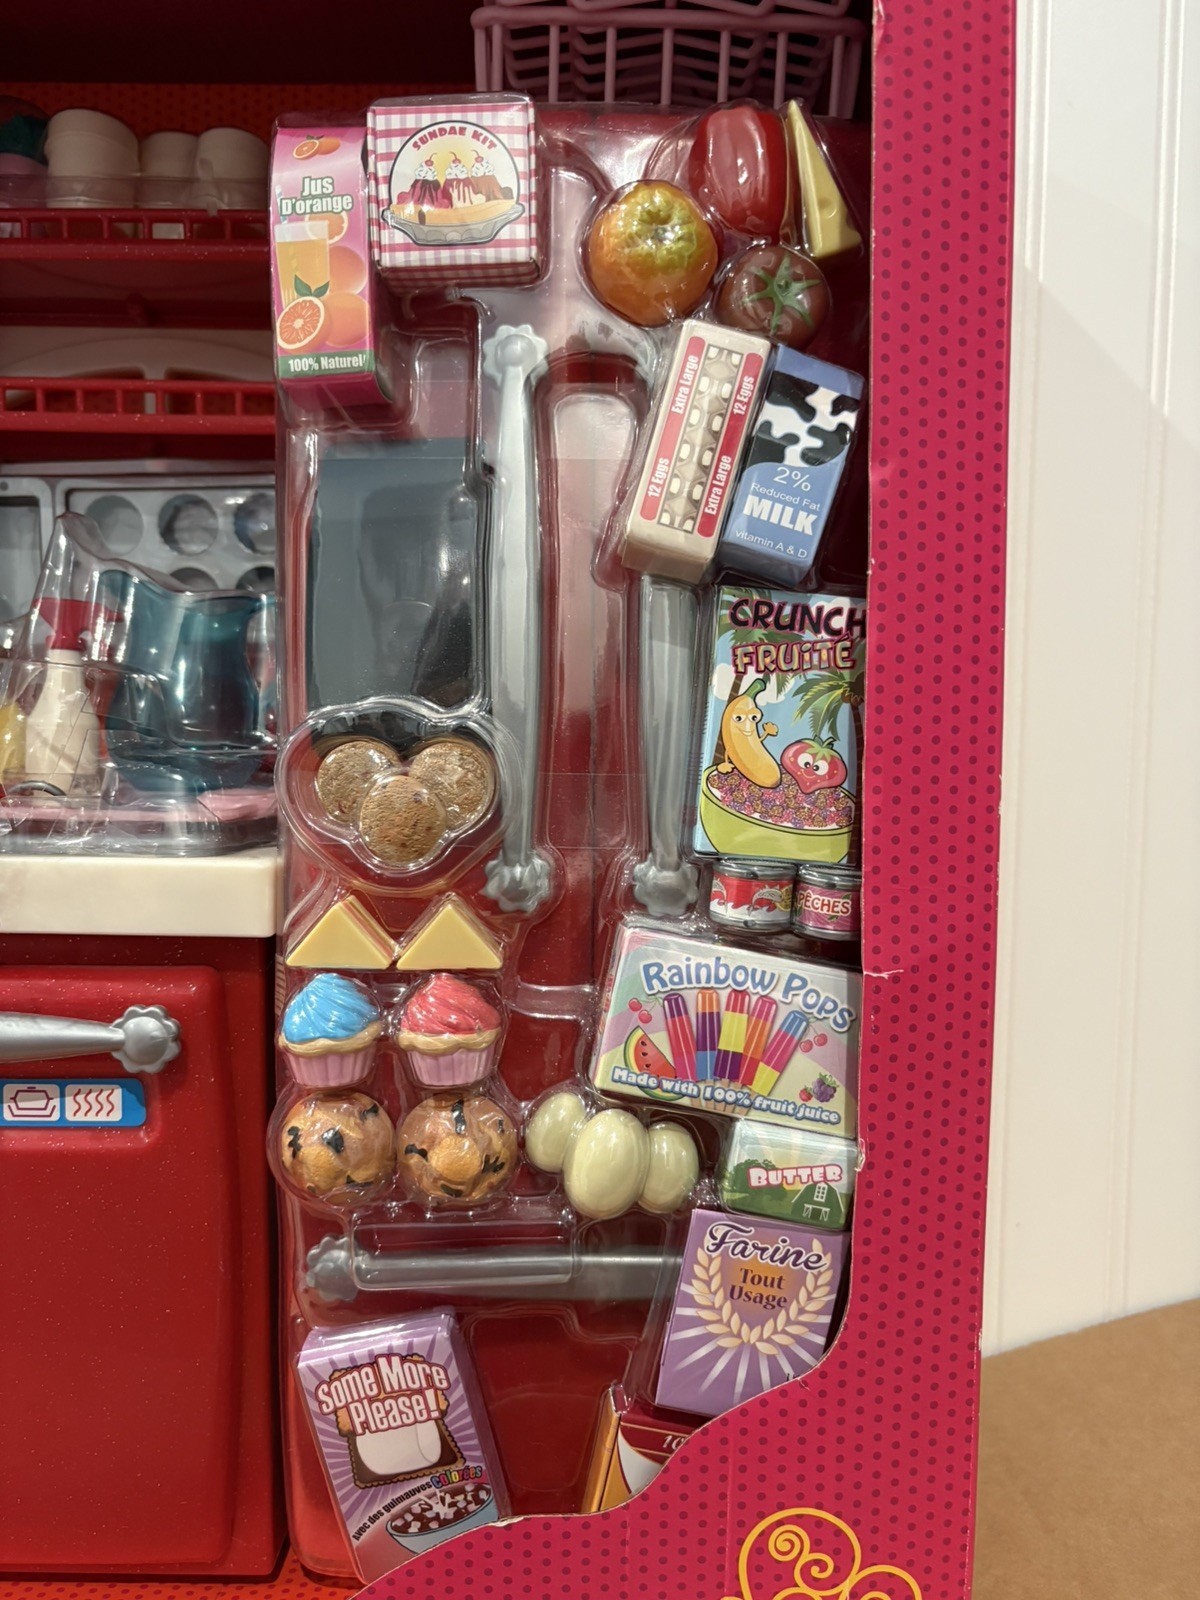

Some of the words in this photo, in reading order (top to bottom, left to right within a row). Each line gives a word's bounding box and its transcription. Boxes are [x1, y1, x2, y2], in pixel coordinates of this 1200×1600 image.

[412, 126, 467, 151] SUNDAE
[471, 130, 497, 150] KIT
[302, 176, 334, 196] Jus
[281, 194, 353, 215] D'orange
[288, 357, 319, 372] 100%
[671, 387, 689, 415] Extra
[680, 354, 699, 387] Large
[737, 376, 755, 402] Eggs
[733, 402, 747, 415] 12
[653, 457, 670, 486] Eggs
[712, 455, 732, 487] Large
[773, 466, 811, 491] 2%
[648, 486, 661, 497] 12
[705, 488, 722, 515] Extra
[751, 482, 801, 504] Reduced
[802, 499, 821, 511] Fat
[743, 494, 818, 536] MILK
[735, 530, 774, 548] vitamin
[775, 543, 784, 552] A
[786, 546, 795, 555] &
[798, 549, 808, 558] D
[642, 956, 776, 993] Rainbow
[613, 1068, 657, 1087] Made
[662, 1079, 699, 1096] with
[704, 1086, 750, 1106] 100%
[754, 1097, 794, 1114] fruit
[795, 1106, 840, 1124] juice
[749, 1165, 843, 1187] BUTTER
[705, 1222, 828, 1271] Farine
[740, 1267, 785, 1289] Tout
[729, 1285, 788, 1310] Usage
[378, 1355, 449, 1393] More
[348, 1389, 440, 1434] Please!
[352, 1522, 371, 1541] Avec
[369, 1510, 384, 1524] des
[382, 1481, 432, 1513] guimauves
